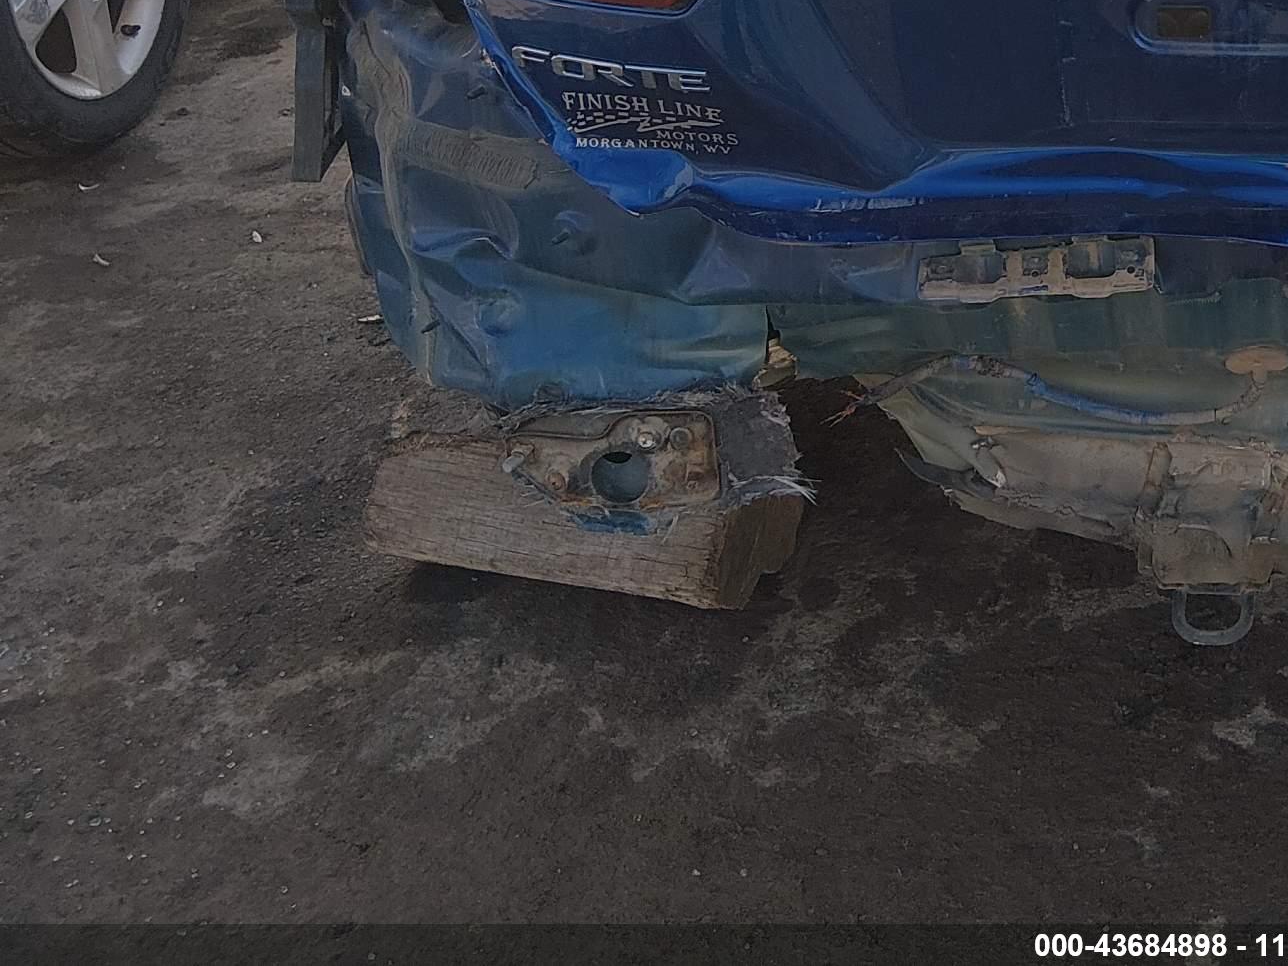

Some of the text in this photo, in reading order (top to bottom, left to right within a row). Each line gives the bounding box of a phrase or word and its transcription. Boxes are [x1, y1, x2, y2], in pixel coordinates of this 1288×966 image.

[511, 45, 711, 93] FORTE
[562, 91, 725, 123] FINISH LINE
[575, 137, 732, 155] MORGANTOWN, WV
[655, 129, 740, 147] MOTORS
